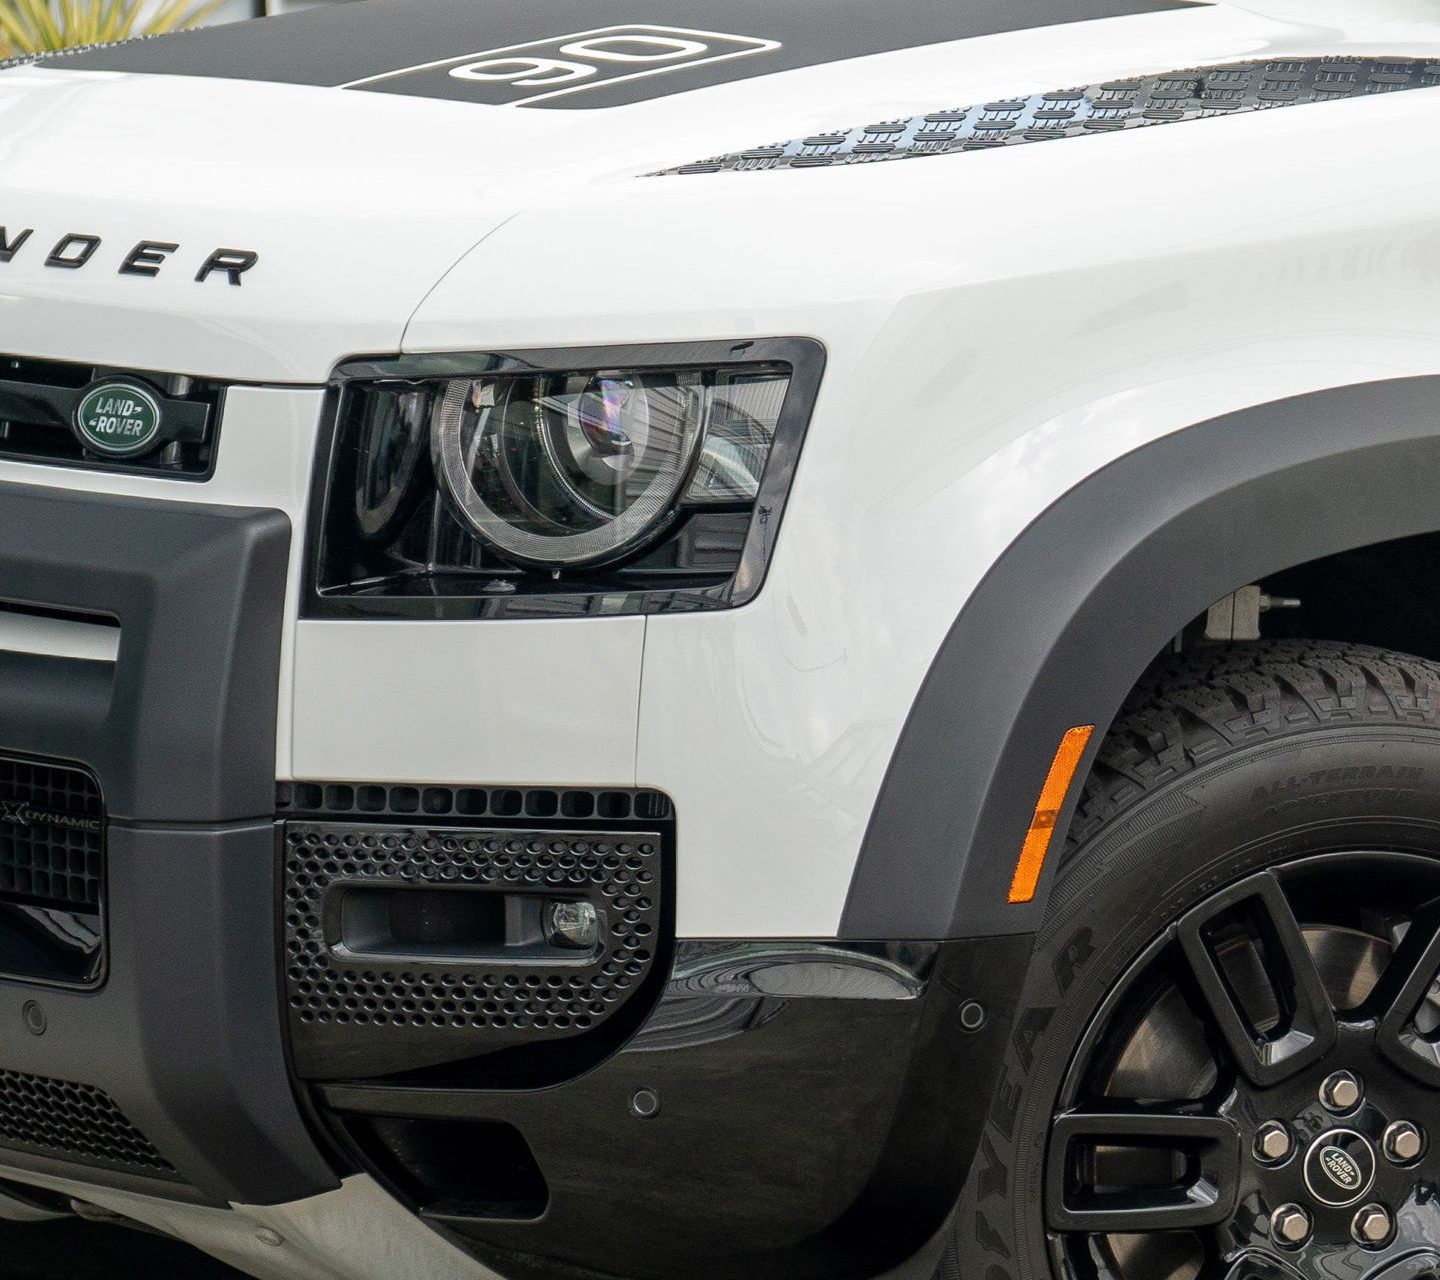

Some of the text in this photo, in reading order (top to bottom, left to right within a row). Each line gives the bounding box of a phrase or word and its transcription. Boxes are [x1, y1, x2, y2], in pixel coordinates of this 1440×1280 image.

[449, 34, 709, 87] 90
[95, 397, 134, 416] LAND
[95, 416, 143, 436] ROVER
[1326, 1159, 1353, 1184] ROVER
[1331, 1152, 1353, 1173] LAND
